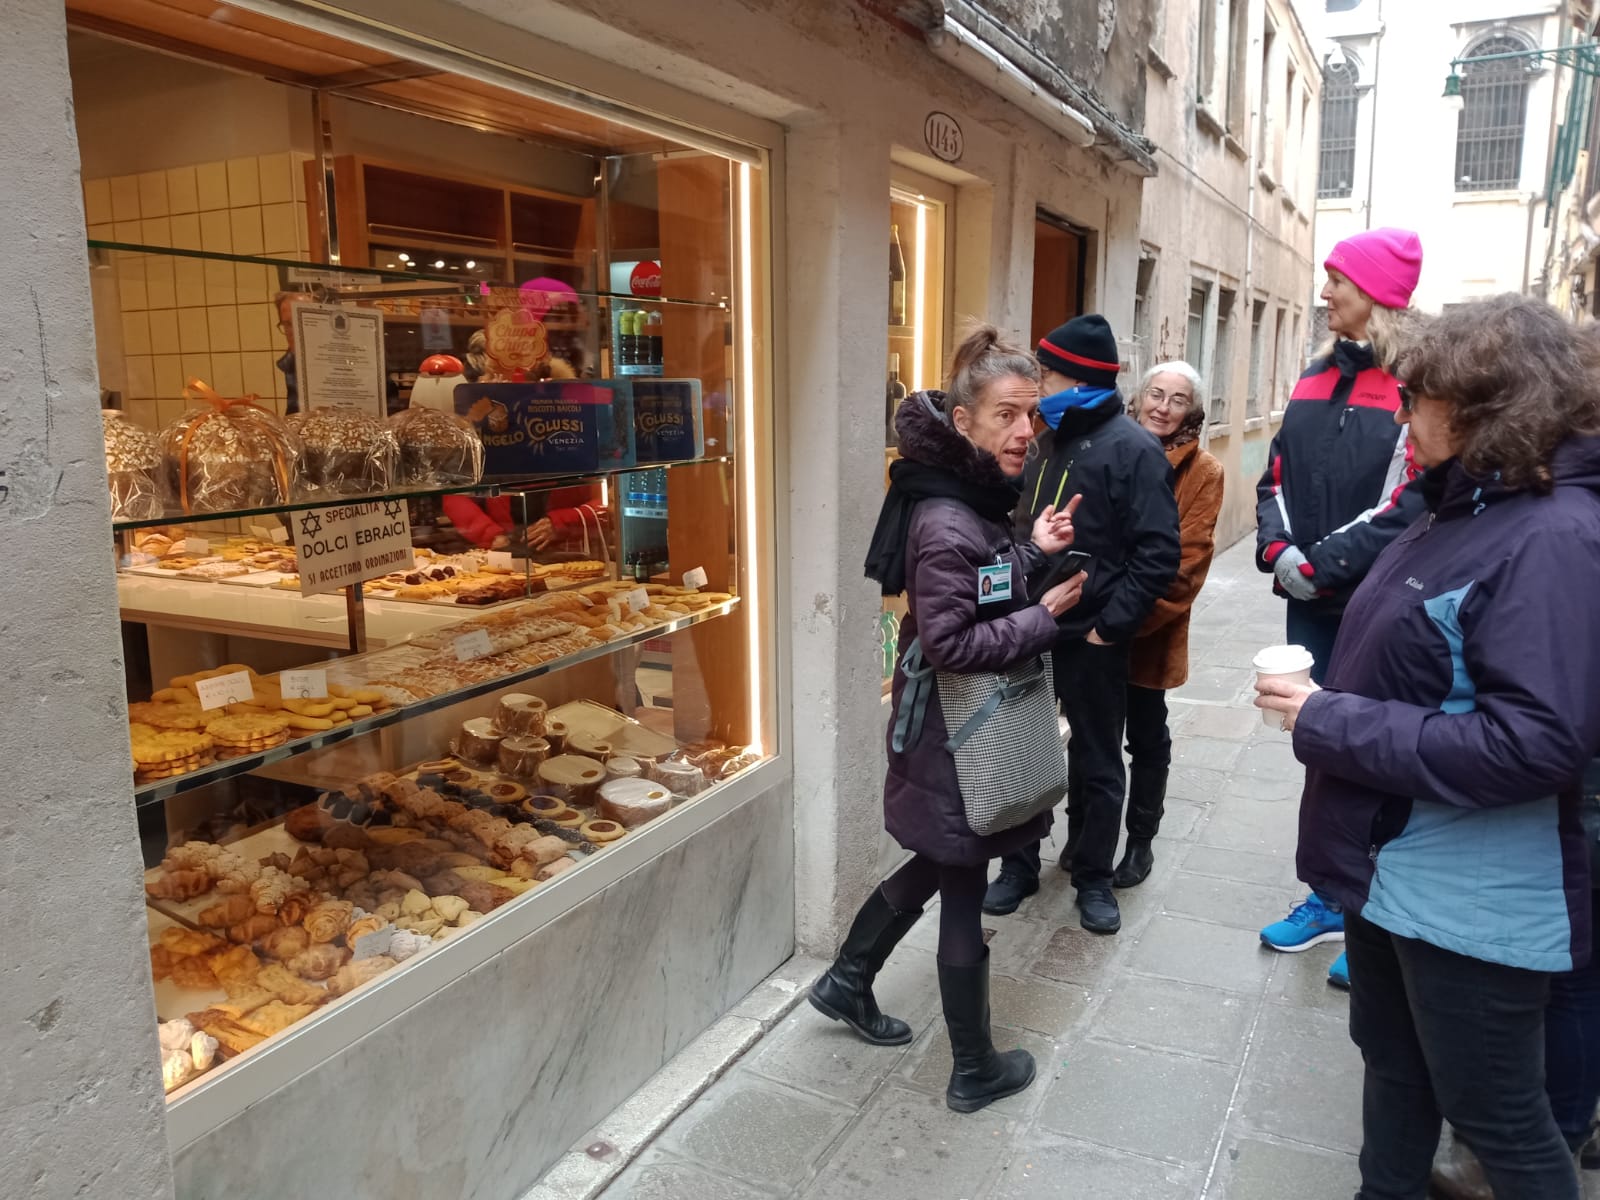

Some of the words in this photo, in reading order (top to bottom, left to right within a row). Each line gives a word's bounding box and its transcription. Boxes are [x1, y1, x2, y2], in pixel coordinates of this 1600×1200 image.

[524, 417, 583, 441] COLUSSI
[638, 412, 684, 432] COLUSSI
[302, 535, 349, 560] DOLCI
[355, 520, 406, 546] EBRAICI
[307, 571, 317, 585] SI
[319, 560, 363, 583] ACCETTANO
[364, 548, 407, 570] ORDINAZIONI
